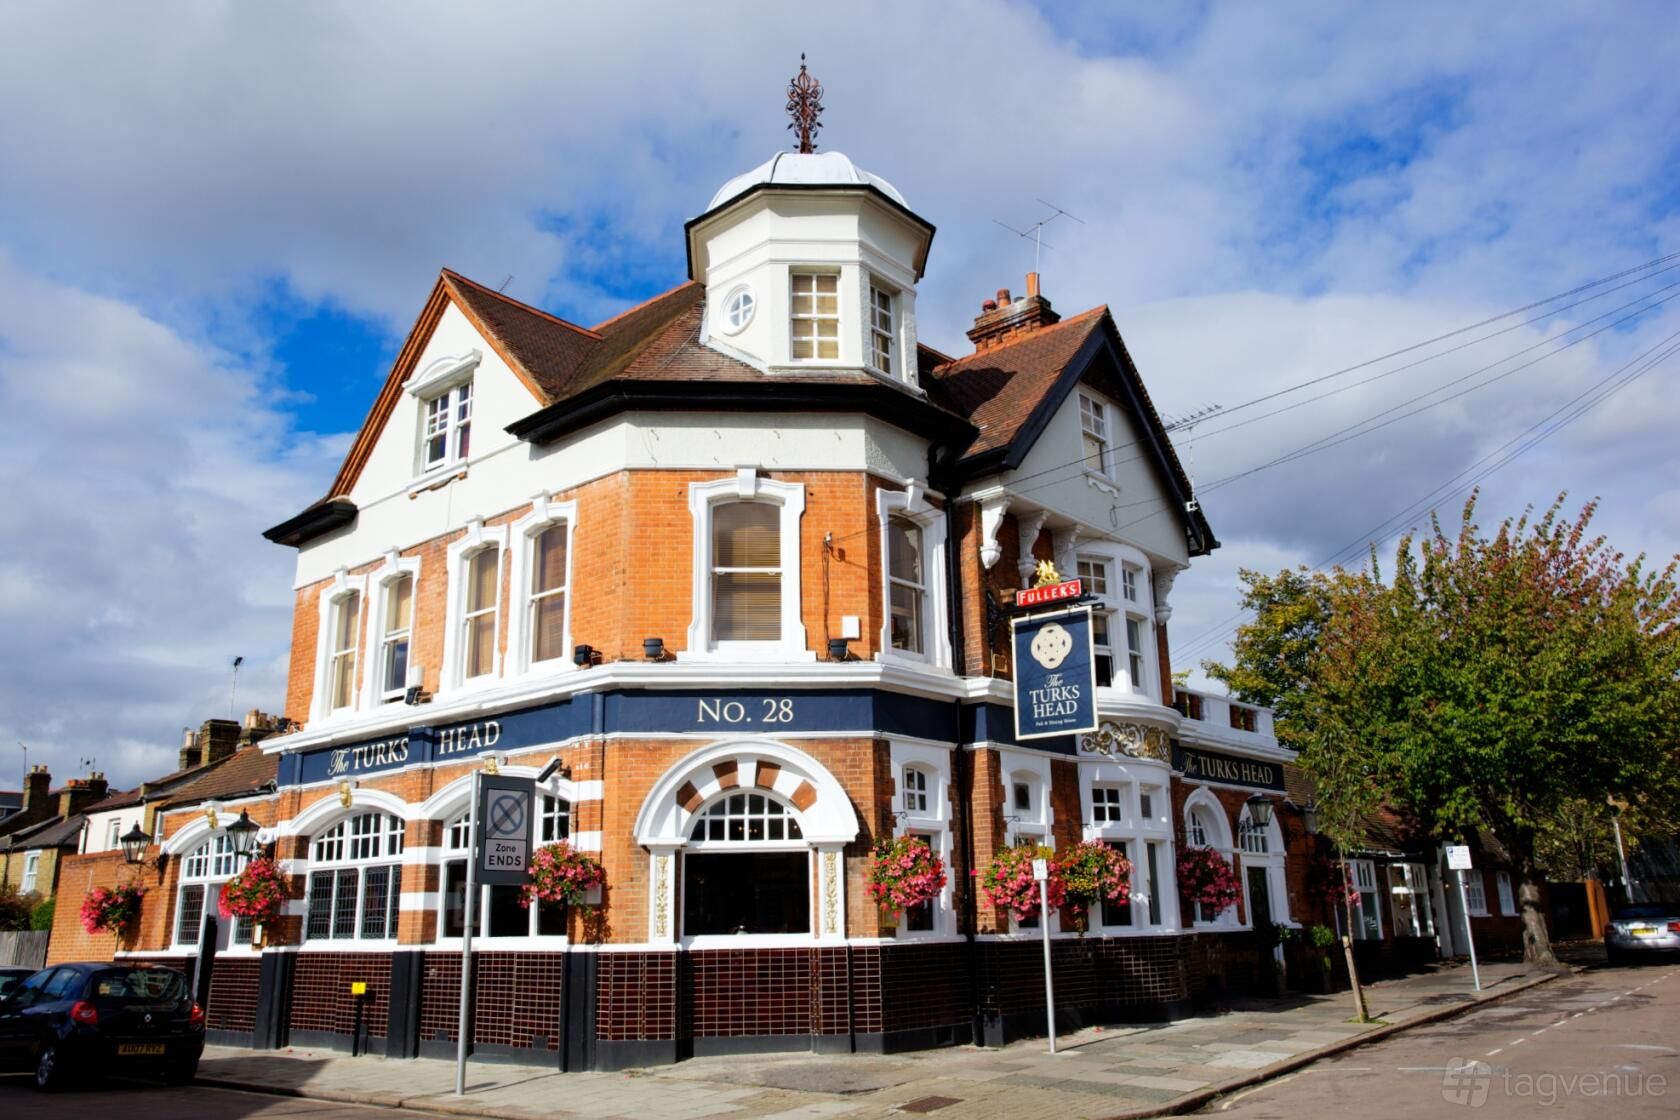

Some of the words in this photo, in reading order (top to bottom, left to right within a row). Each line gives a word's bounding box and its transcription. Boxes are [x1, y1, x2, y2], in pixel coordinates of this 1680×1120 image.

[1019, 583, 1077, 604] FULLER'S
[1044, 674, 1063, 688] The
[1029, 684, 1080, 704] TURKS
[697, 699, 752, 722] No.
[762, 699, 794, 722] 28
[1033, 700, 1078, 719] HEAD
[327, 747, 350, 776] The
[351, 737, 409, 770] TURKS
[439, 721, 500, 755] HEAD
[1183, 752, 1197, 774] The
[1199, 756, 1239, 780] TURKS
[1241, 763, 1273, 785] HEAD
[495, 843, 516, 853] Zone
[488, 855, 521, 867] ENDS
